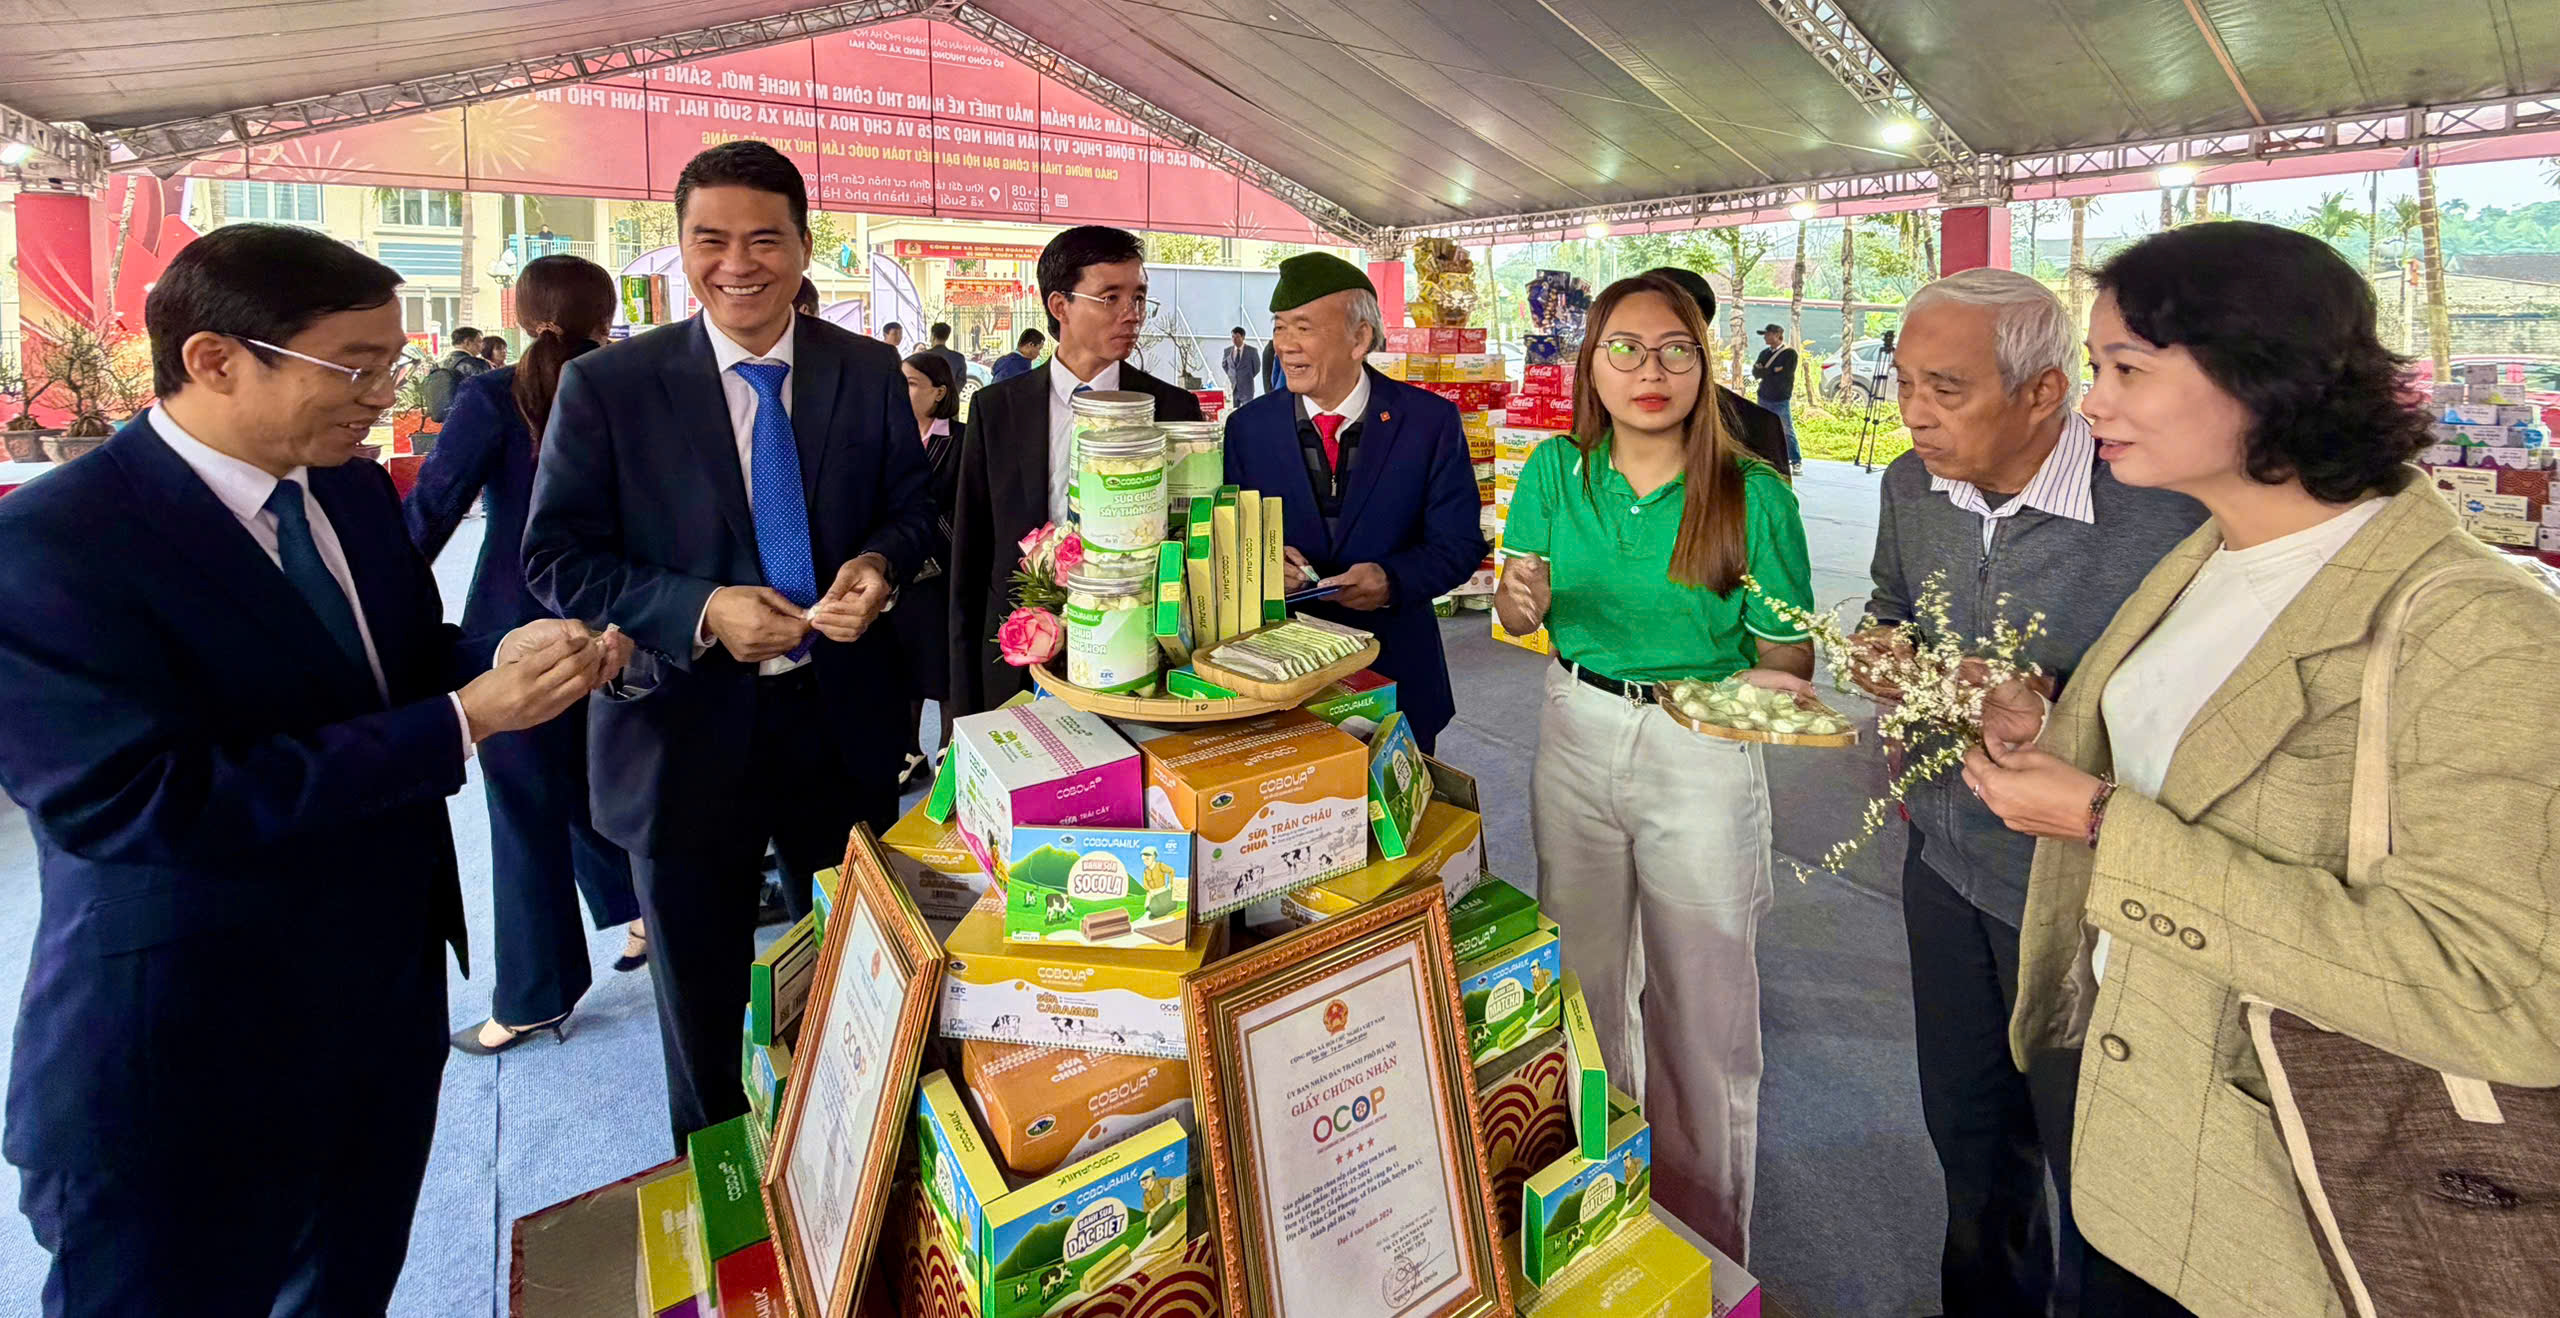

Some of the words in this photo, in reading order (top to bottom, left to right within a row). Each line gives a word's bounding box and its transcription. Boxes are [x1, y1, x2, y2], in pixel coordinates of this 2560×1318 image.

[1248, 828, 1269, 843] SỮA
[1272, 816, 1299, 833] TRÂN
[1302, 808, 1333, 826] CHÂU
[1240, 840, 1269, 856] CHUA
[1074, 873, 1123, 895] SOCOLA
[1160, 1003, 1179, 1012] OCO
[1488, 992, 1521, 1020] MATCHA
[1051, 1064, 1088, 1084] CHUA
[1291, 1092, 1320, 1118] GIẤY
[1322, 1073, 1364, 1102] CHỨNG
[1366, 1056, 1398, 1081] NHẬN
[1296, 1084, 1310, 1095] BAN
[1313, 1085, 1386, 1143] OCOP
